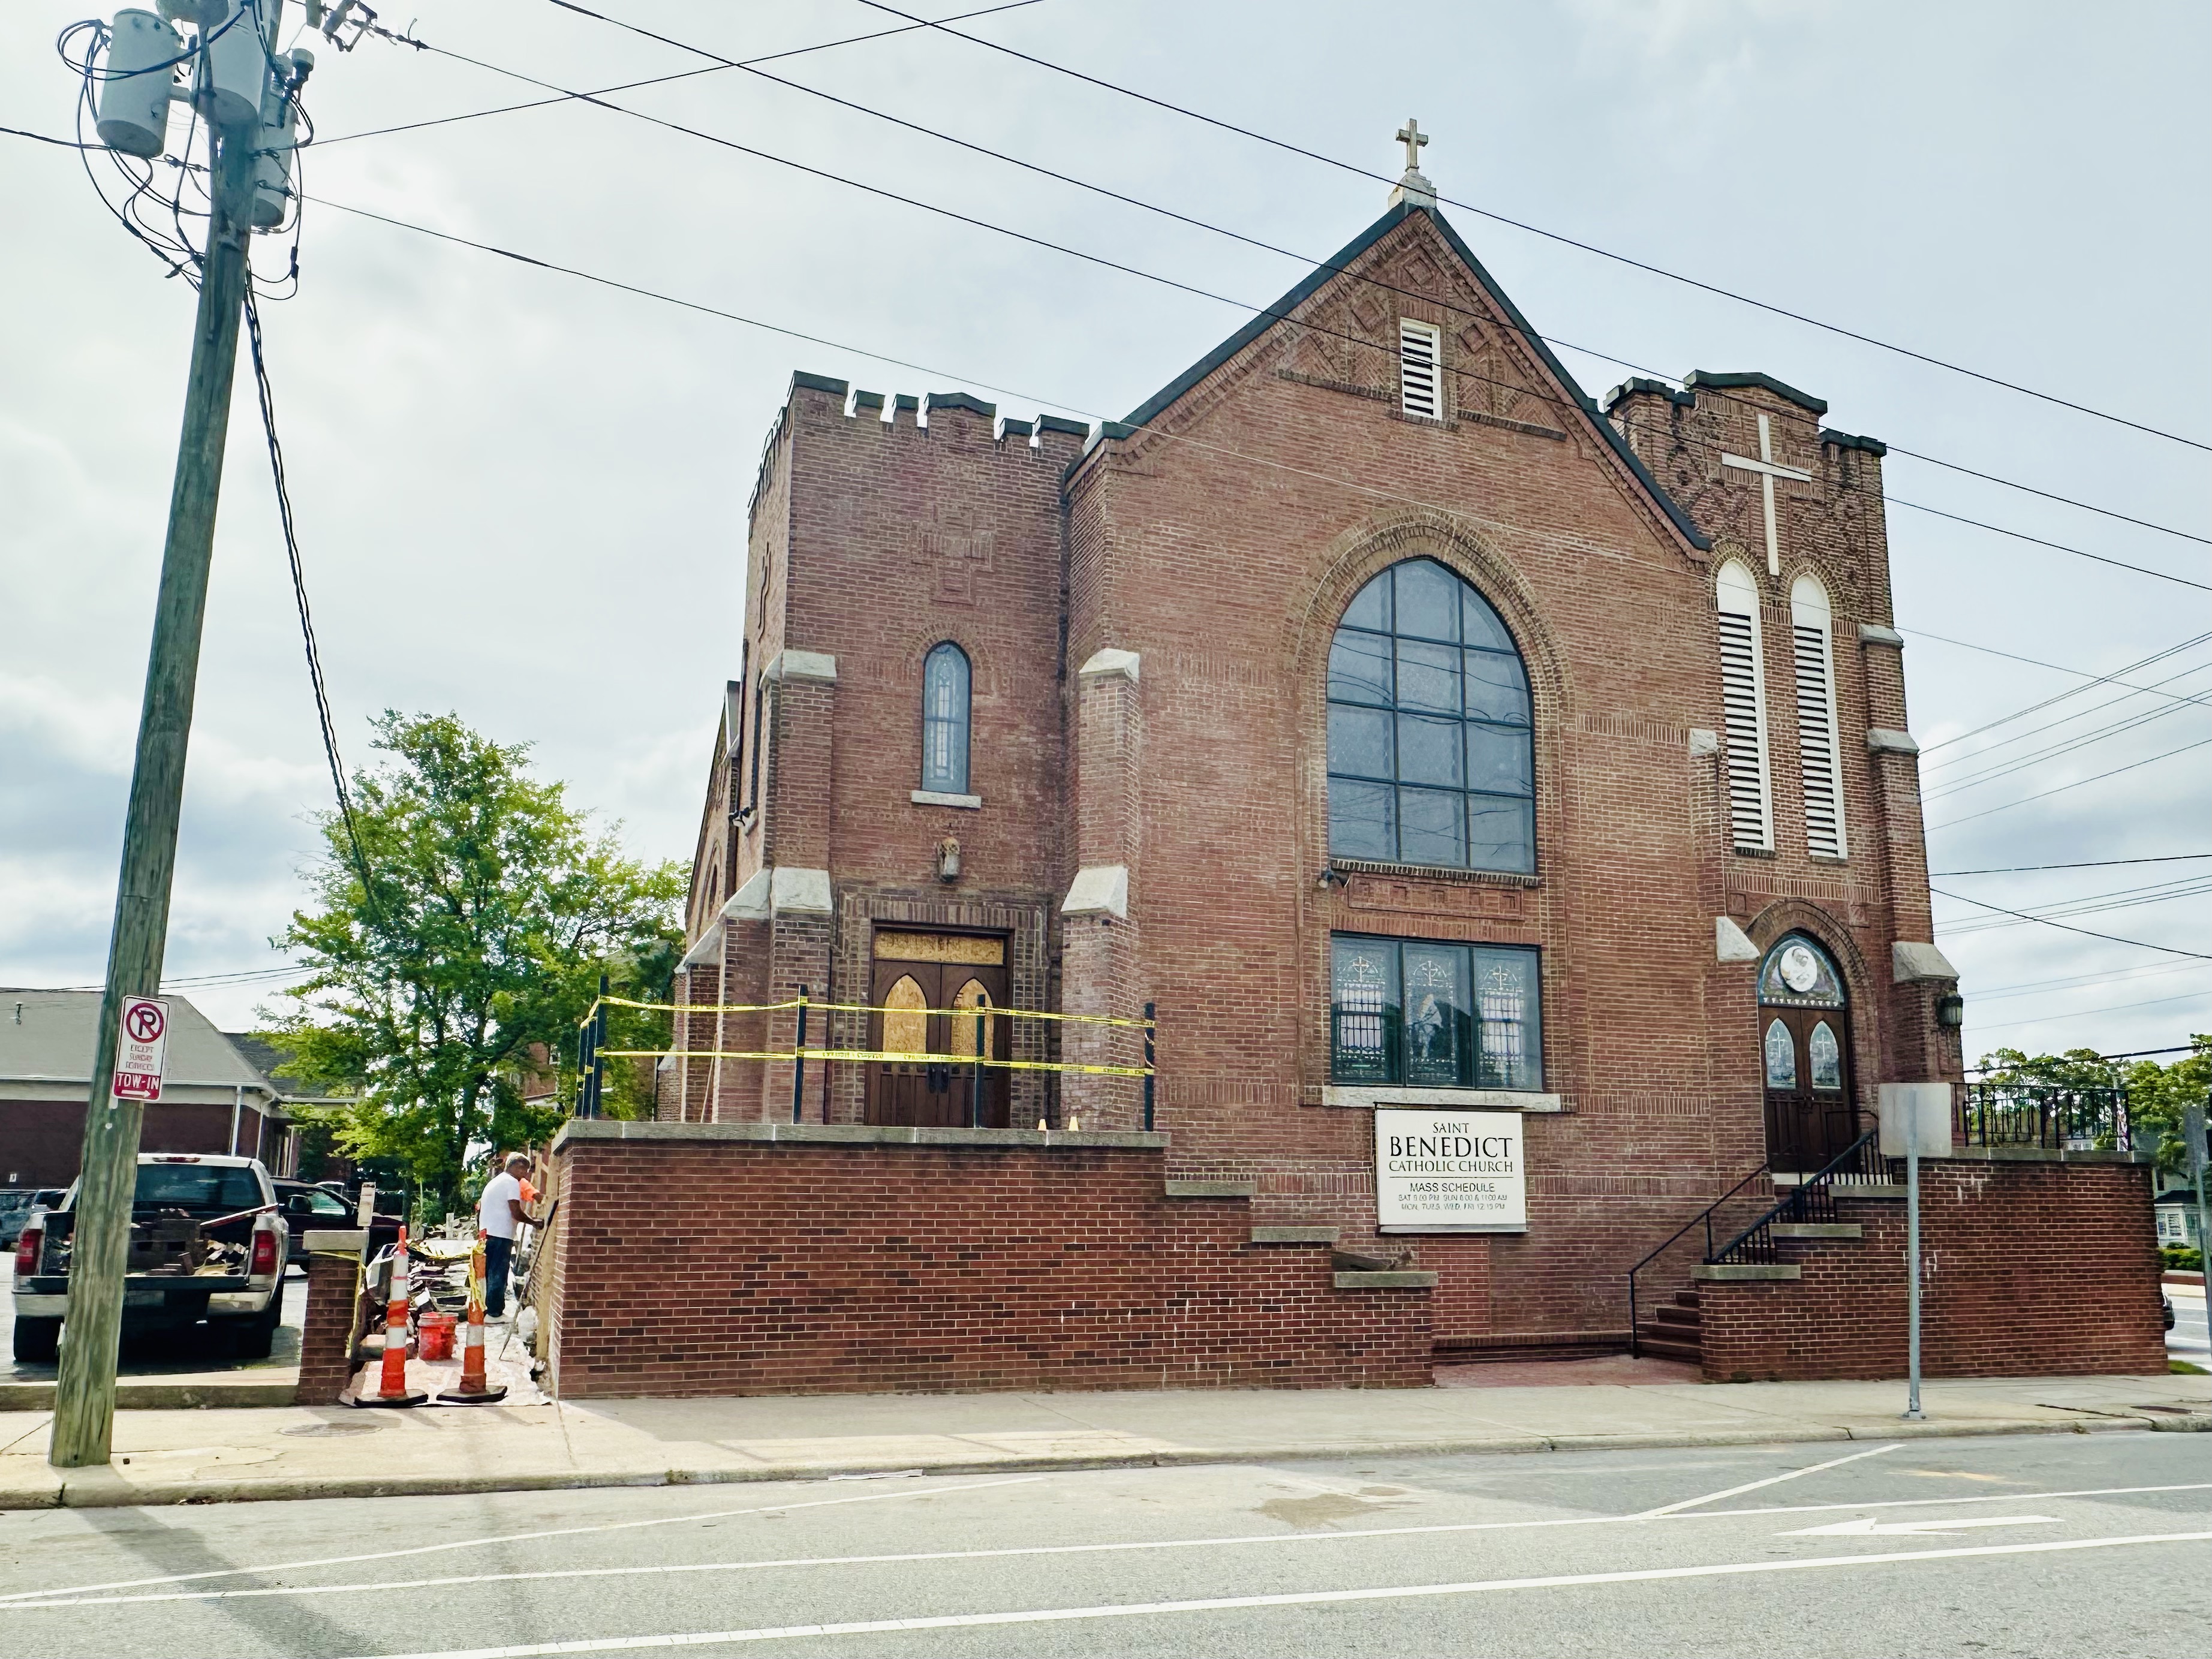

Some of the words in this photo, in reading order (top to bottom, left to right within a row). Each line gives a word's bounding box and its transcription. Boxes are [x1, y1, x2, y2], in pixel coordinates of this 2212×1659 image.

[117, 1073, 159, 1090] TOW-IN
[1433, 1122, 1469, 1133] SAINT
[1390, 1136, 1513, 1158] BENEDICT
[1389, 1160, 1456, 1172] CATHOLIC
[1459, 1160, 1513, 1172] CHURCH
[1410, 1182, 1438, 1192] MASS
[1441, 1182, 1495, 1193] SCHEDULE
